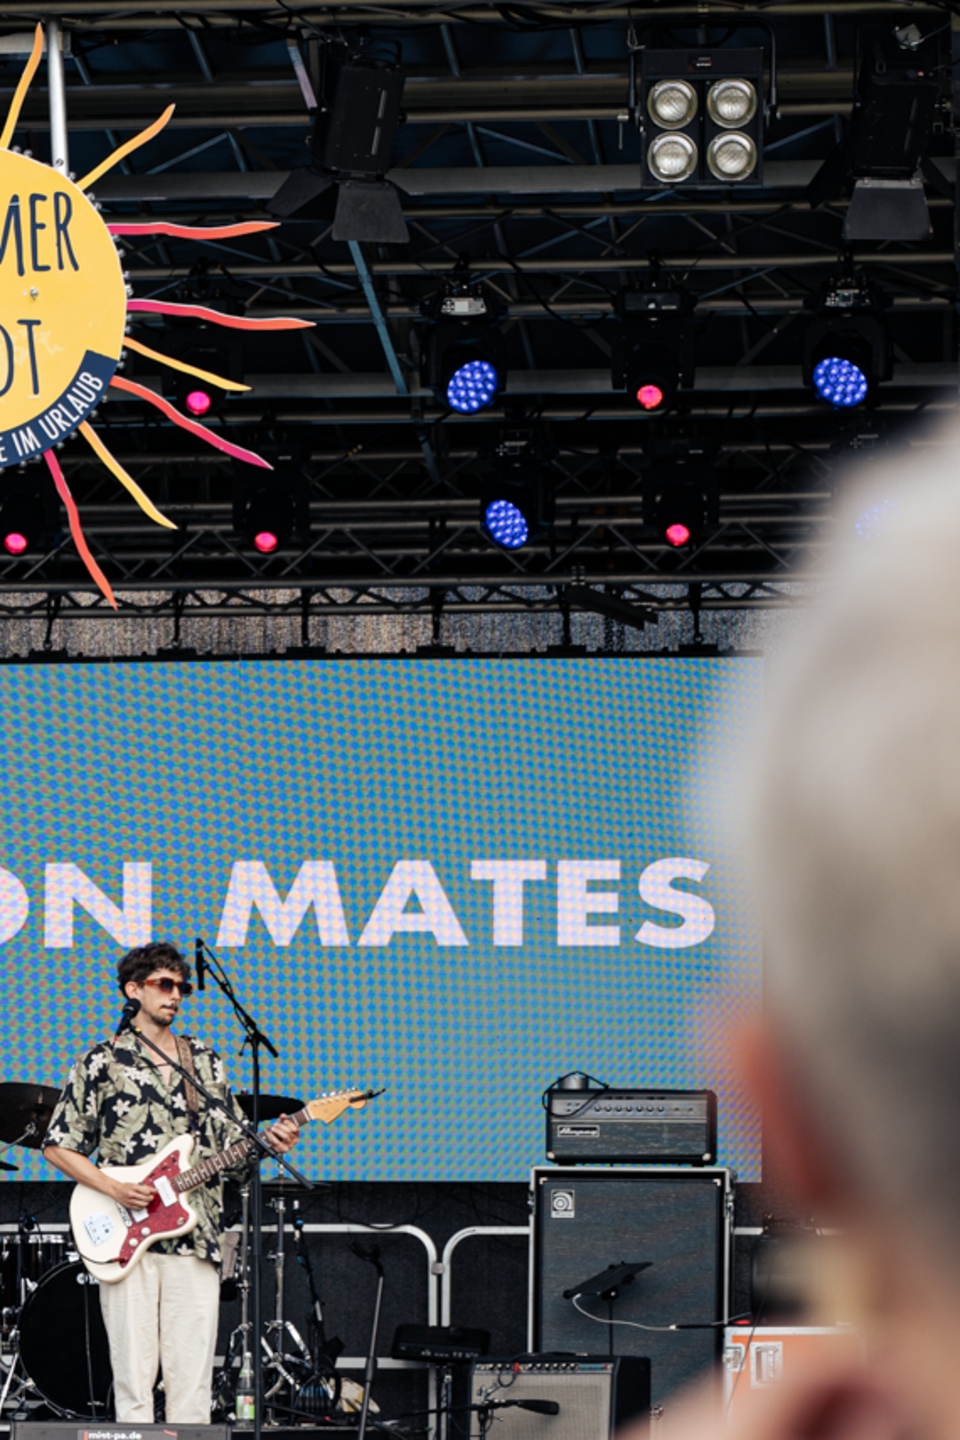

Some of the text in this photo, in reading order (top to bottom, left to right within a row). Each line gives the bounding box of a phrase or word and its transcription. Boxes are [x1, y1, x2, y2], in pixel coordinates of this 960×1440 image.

[12, 426, 42, 457] IM
[38, 371, 104, 440] URLAUB
[216, 857, 716, 949] MATES
